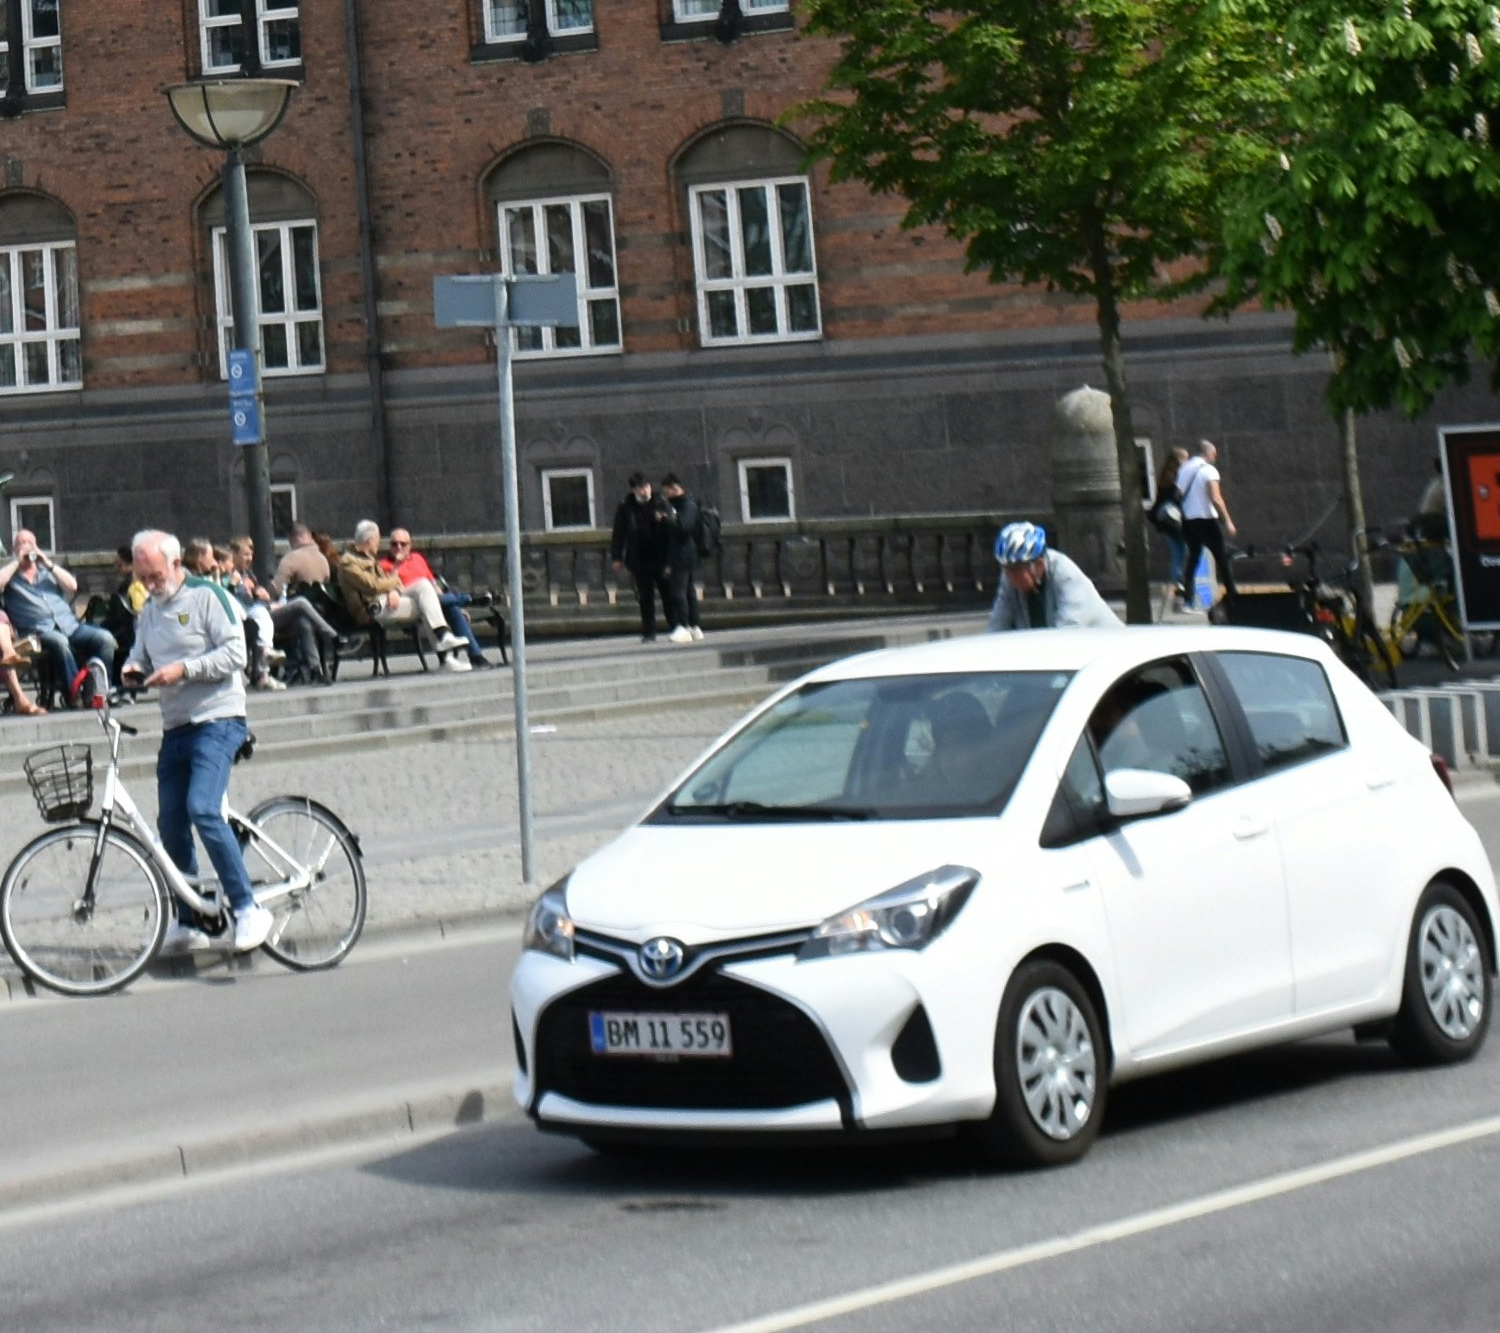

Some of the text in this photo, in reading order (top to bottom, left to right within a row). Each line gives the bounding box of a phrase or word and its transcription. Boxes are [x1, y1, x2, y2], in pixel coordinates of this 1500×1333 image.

[607, 1020, 726, 1049] BM 11 559
